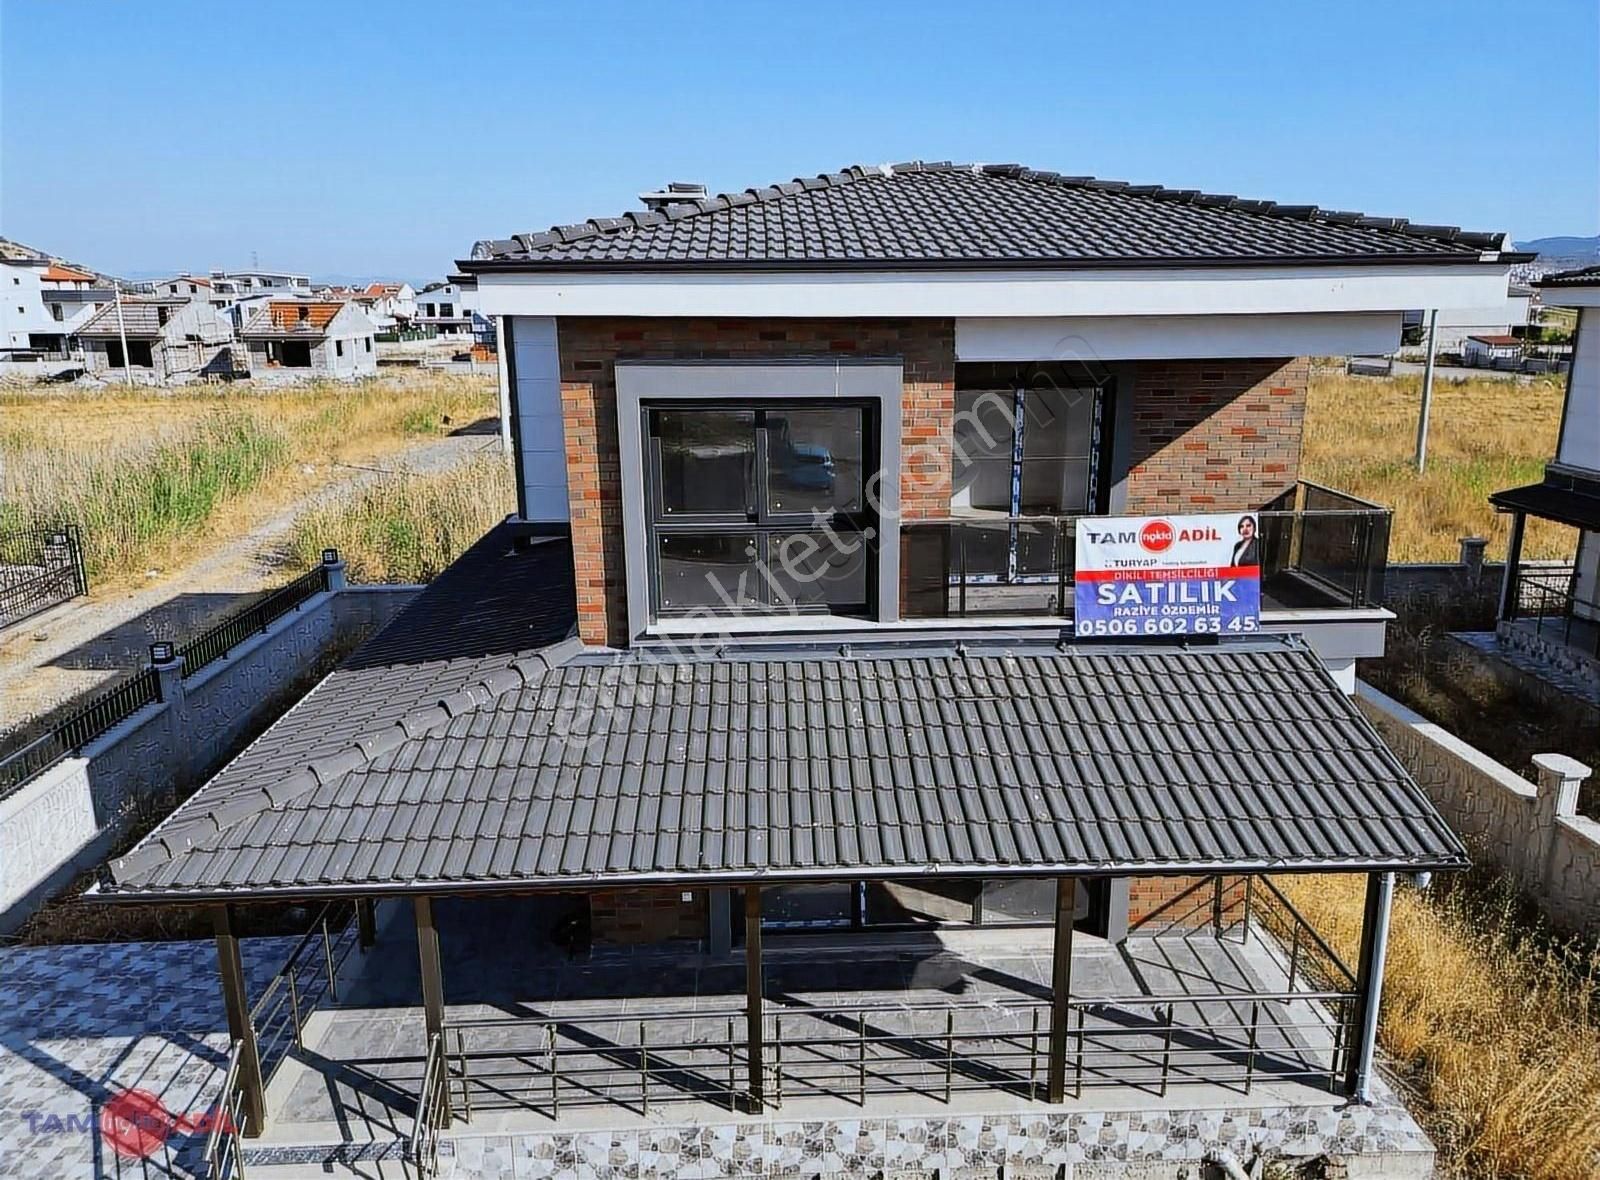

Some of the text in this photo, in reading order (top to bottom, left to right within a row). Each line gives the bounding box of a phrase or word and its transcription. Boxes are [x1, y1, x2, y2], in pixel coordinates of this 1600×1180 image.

[1087, 532, 1136, 544] TAM
[1179, 525, 1222, 542] ADİL
[1114, 558, 1157, 568] TURYAP
[1114, 570, 1147, 580] DİKİLİ
[1097, 581, 1237, 605] SATILIK
[1114, 602, 1221, 616] RAZİYE ÖZDEMİR
[1079, 620, 1137, 635] 0506
[1144, 618, 1188, 634] 602
[1194, 617, 1221, 633] 63
